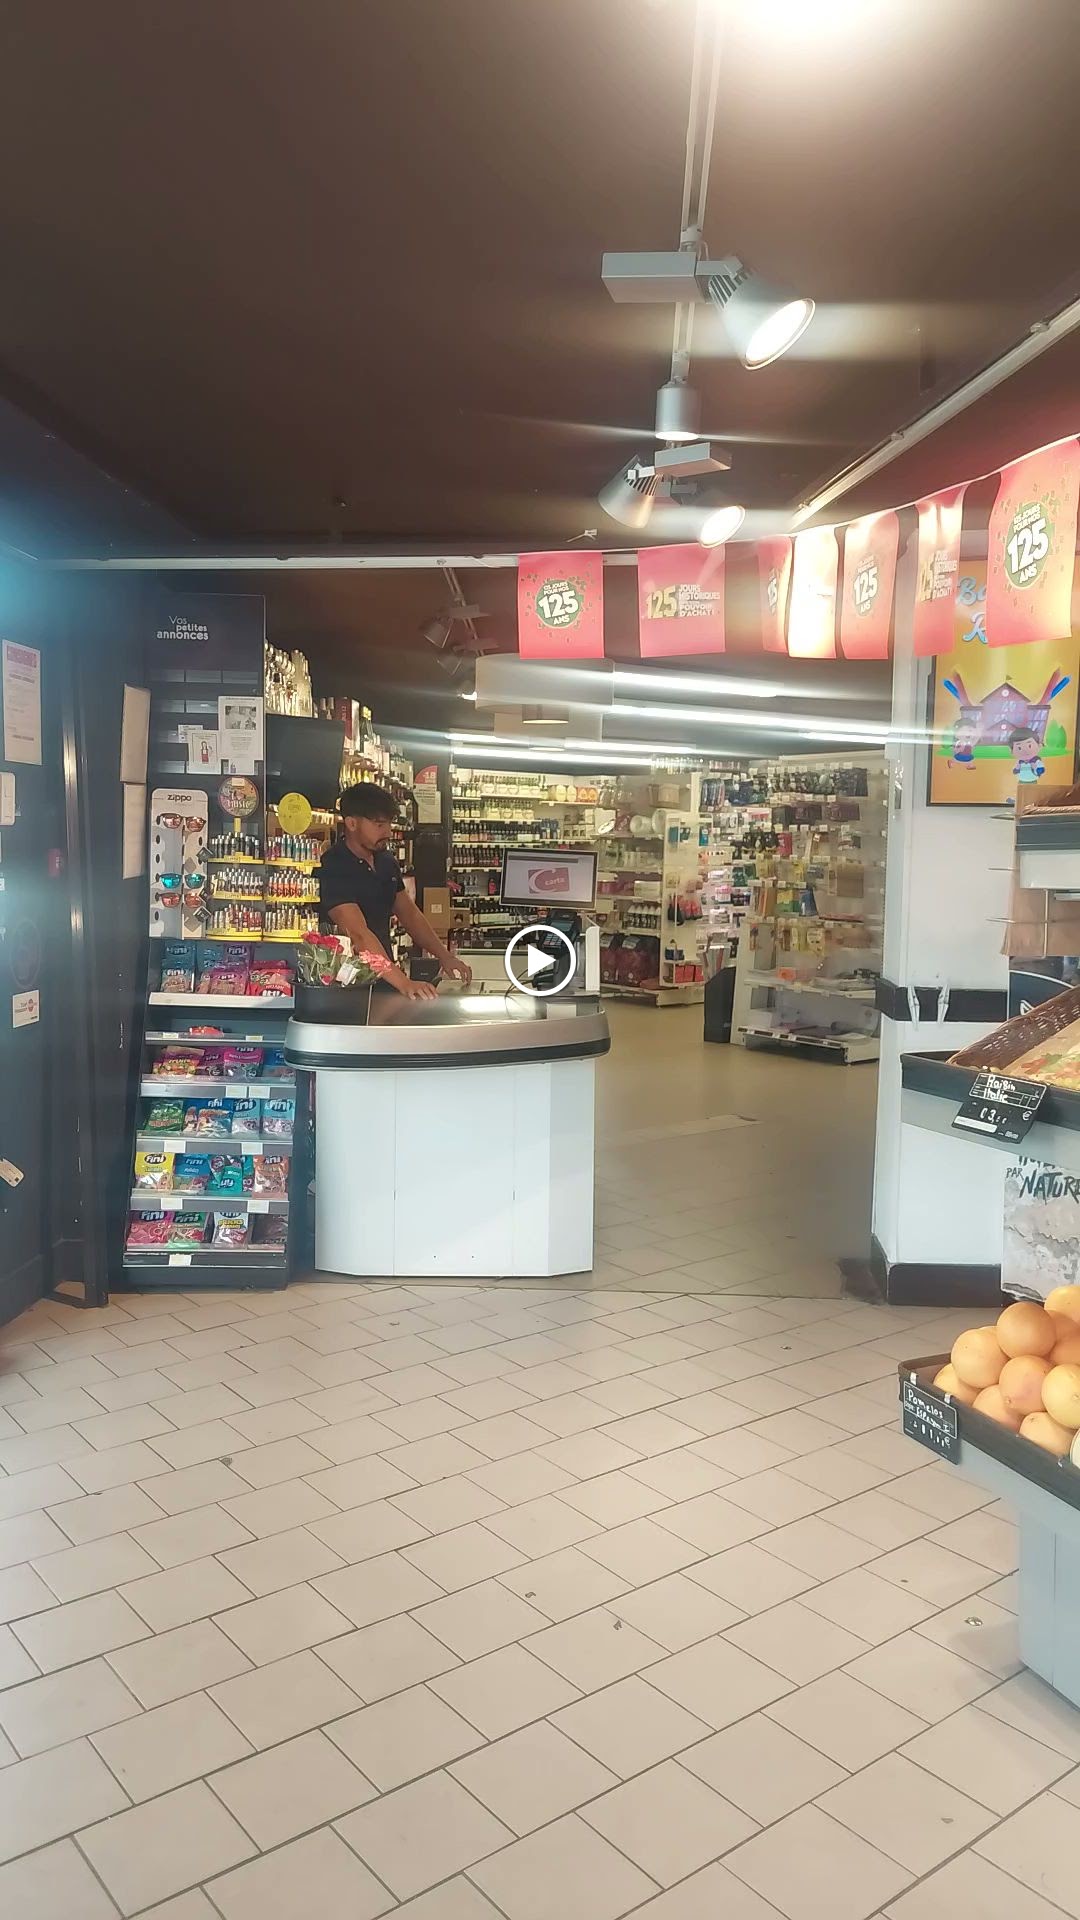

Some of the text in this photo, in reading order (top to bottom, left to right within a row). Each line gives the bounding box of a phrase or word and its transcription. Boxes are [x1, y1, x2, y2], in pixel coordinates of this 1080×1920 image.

[1007, 517, 1049, 574] 125
[1019, 563, 1038, 583] ANS
[679, 584, 701, 593] JOURS
[853, 566, 879, 605] 125
[679, 591, 721, 601] HISTORIQUES
[538, 590, 579, 619] 125
[646, 586, 677, 620] 125
[169, 615, 188, 625] Vos
[553, 615, 570, 625] ANS
[176, 624, 208, 632] petites
[156, 630, 209, 640] annonces
[167, 794, 192, 802] zippo
[1022, 1110, 1033, 1121] €
[146, 1152, 165, 1162] Fini
[1006, 1167, 1024, 1180] PAR
[908, 1389, 943, 1419] Pomelos
